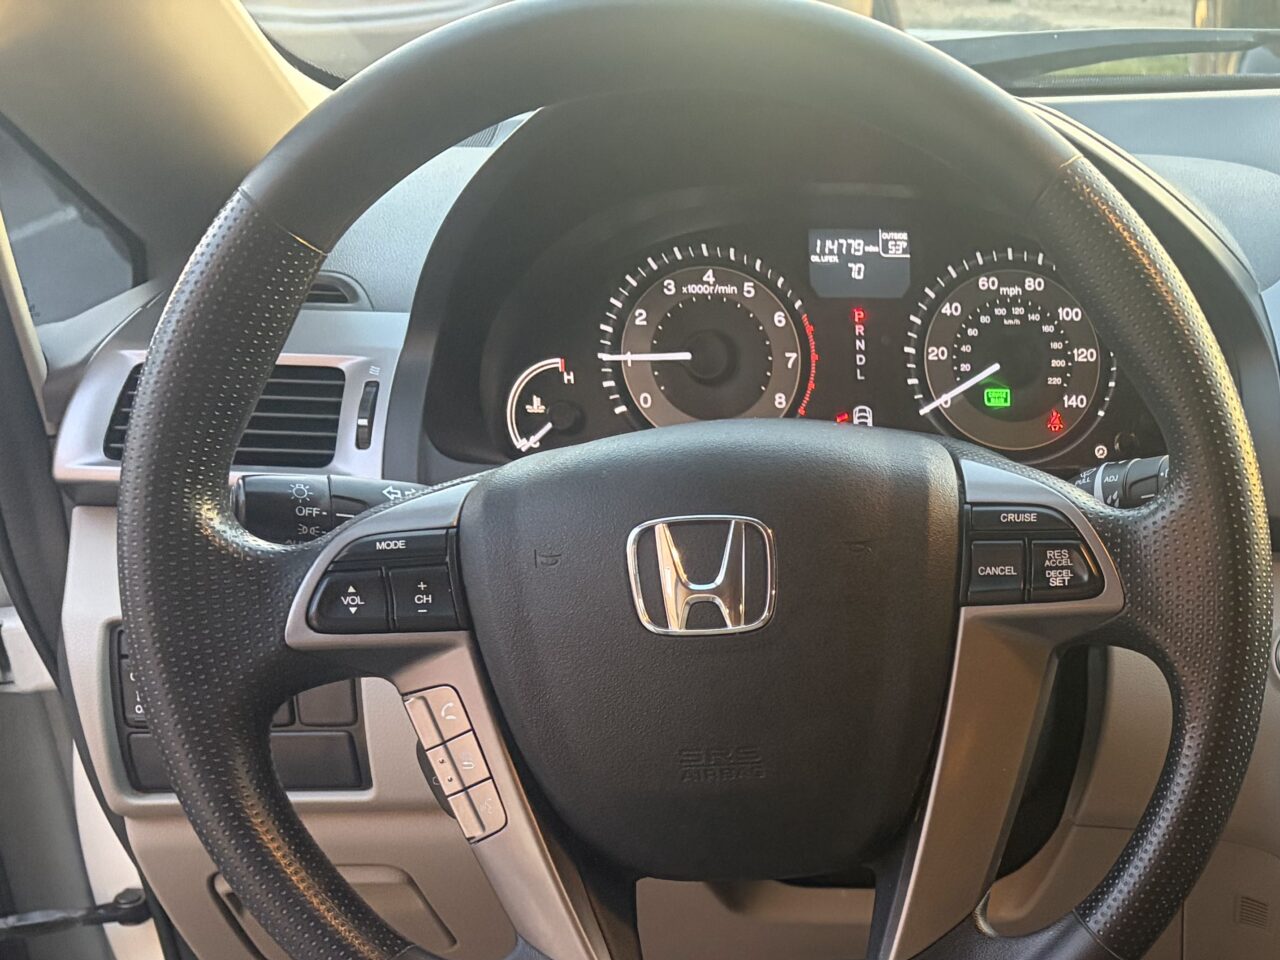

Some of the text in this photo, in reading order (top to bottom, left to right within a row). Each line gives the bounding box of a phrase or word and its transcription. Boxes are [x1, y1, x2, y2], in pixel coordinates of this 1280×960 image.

[702, 269, 715, 284] 4
[663, 279, 676, 295] 3
[978, 276, 999, 290] 60
[1024, 277, 1045, 291] 80
[743, 282, 755, 297] 5
[1000, 285, 1022, 297] mph
[941, 302, 962, 316] 40
[994, 308, 1007, 316] 100
[1012, 307, 1025, 315] 120
[1058, 307, 1082, 321] 100
[635, 309, 647, 326] 2
[774, 311, 786, 327] 6
[854, 310, 866, 323] P
[980, 315, 991, 323] 80
[855, 325, 865, 336] R
[967, 329, 978, 337] 60
[1042, 325, 1054, 333] 160
[856, 339, 865, 351] N
[856, 354, 866, 366] D
[927, 347, 948, 361] 20
[1073, 348, 1097, 362] 120
[785, 353, 797, 368] 7
[960, 364, 971, 372] 20
[564, 372, 574, 384] H
[857, 369, 865, 380] L
[1048, 377, 1062, 385] 220
[640, 393, 652, 408] 0
[774, 393, 787, 409] 8
[1063, 395, 1087, 408] 140
[295, 506, 320, 518] OFF
[1000, 513, 1038, 523] CRUISE
[376, 540, 406, 550] MODE
[1046, 550, 1069, 559] RES
[1044, 559, 1073, 567] ACCEL
[978, 566, 1017, 576] CANCEL
[1045, 570, 1074, 578] DECEL
[1049, 577, 1070, 587] SET
[341, 595, 365, 605] VOL
[414, 594, 432, 604] CH
